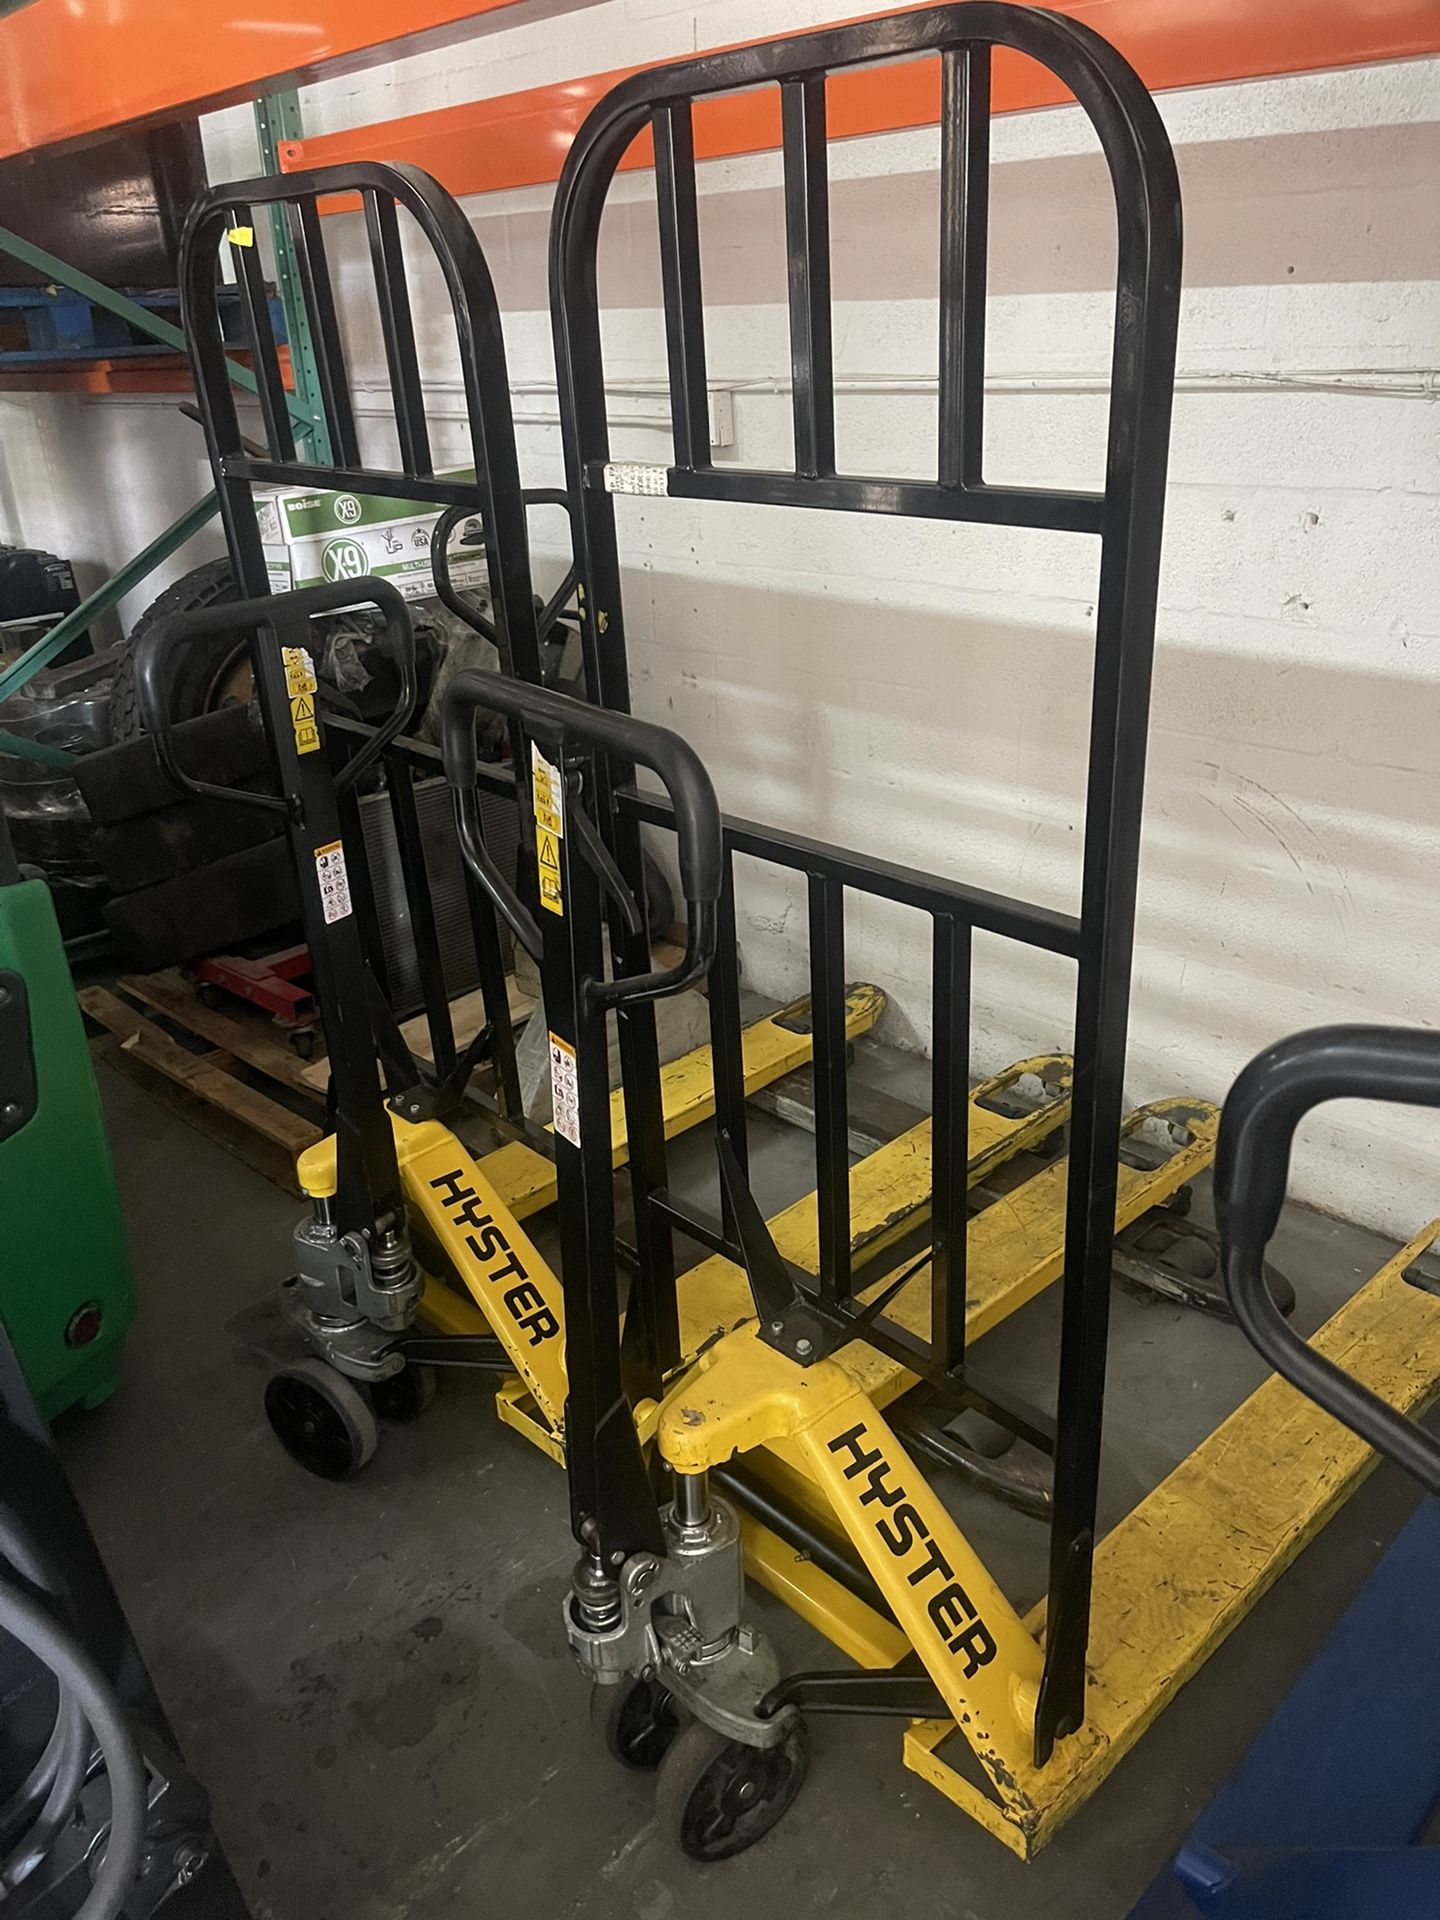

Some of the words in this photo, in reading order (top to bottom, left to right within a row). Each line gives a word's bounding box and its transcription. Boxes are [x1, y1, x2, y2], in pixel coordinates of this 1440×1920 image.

[414, 536, 429, 547] USA
[429, 1168, 561, 1347] HYSTER
[826, 1421, 998, 1680] HYSTER
